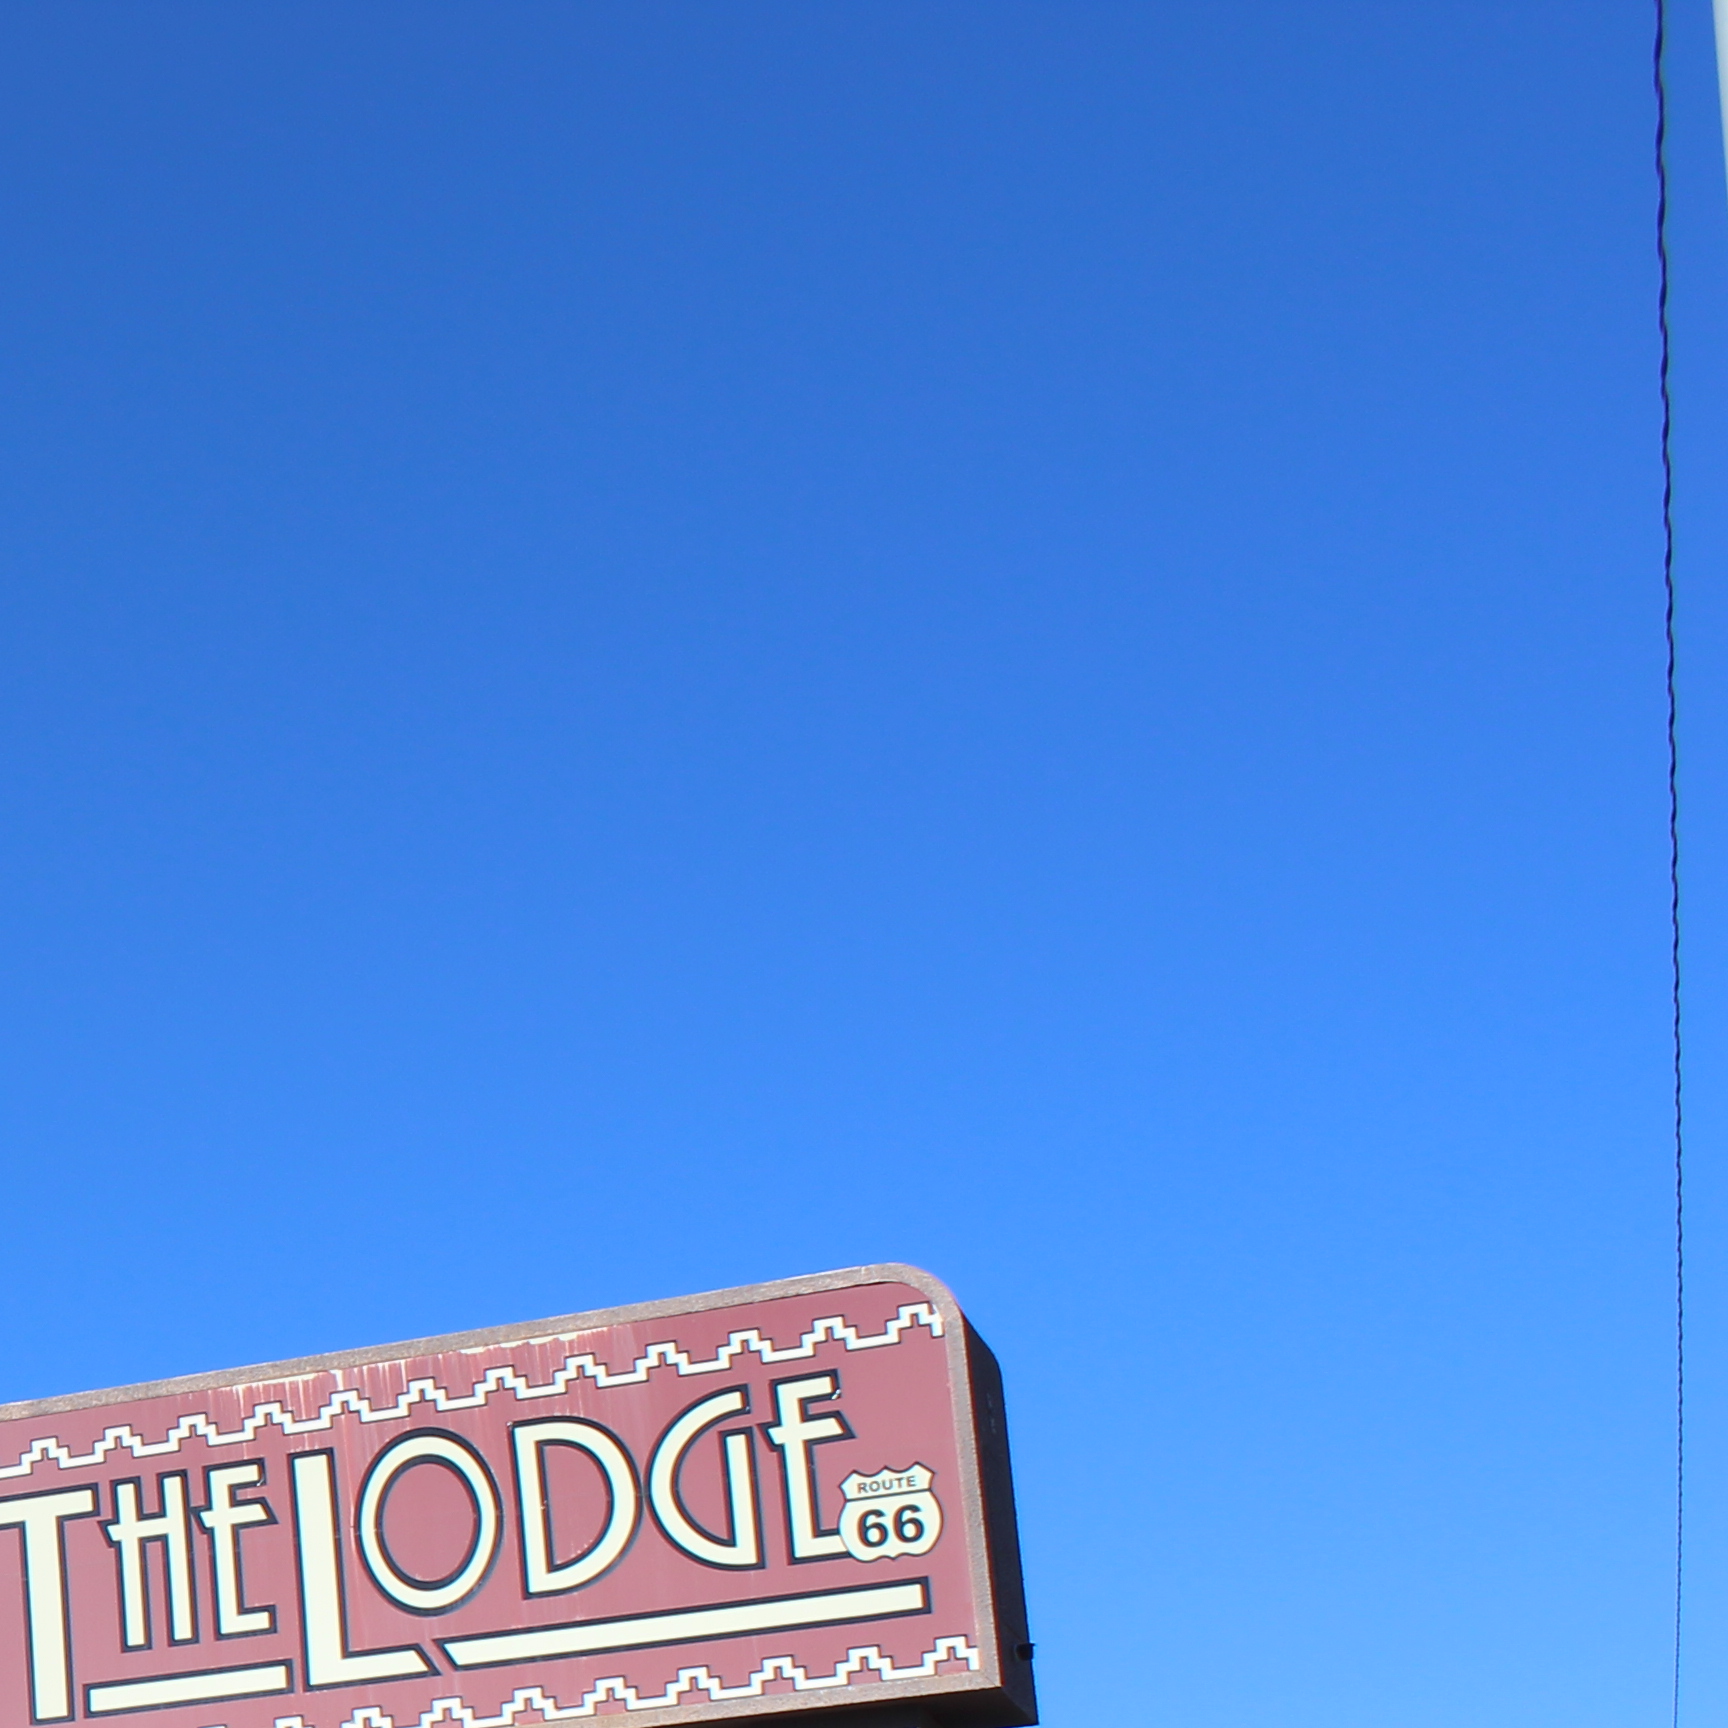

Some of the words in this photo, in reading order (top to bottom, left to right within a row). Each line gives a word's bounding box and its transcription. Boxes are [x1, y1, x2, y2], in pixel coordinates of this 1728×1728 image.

[857, 1475, 917, 1494] ROUTE
[287, 1369, 856, 1692] LODGE
[856, 1504, 925, 1548] 66
